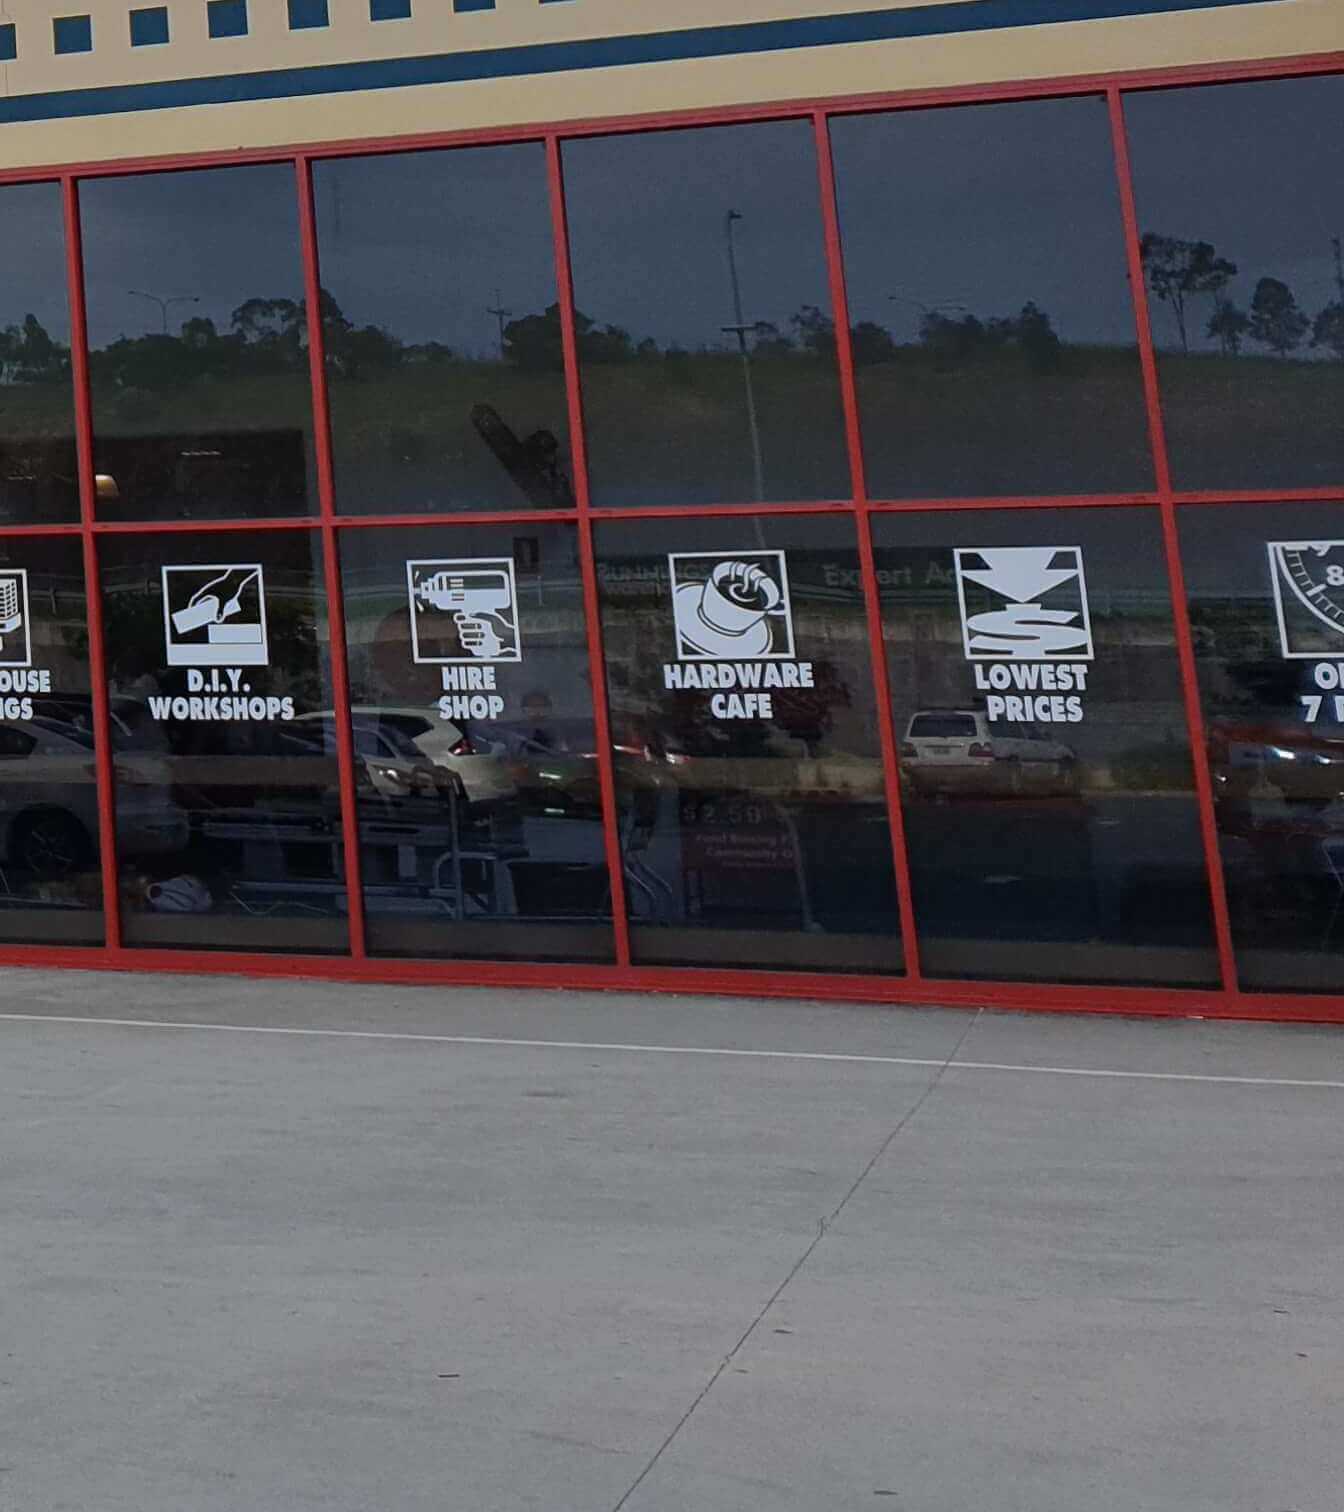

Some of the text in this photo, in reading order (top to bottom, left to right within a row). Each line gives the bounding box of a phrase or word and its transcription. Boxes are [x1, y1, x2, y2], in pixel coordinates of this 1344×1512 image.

[823, 564, 912, 586] Exert
[187, 669, 251, 692] D.I.Y.
[441, 666, 497, 691] HIRE
[663, 662, 814, 689] HARDWARE
[973, 664, 1089, 691] LOWEST
[148, 696, 295, 720] WORKSHOPS
[439, 695, 504, 720] SHOP
[711, 693, 773, 719] CAFE
[986, 695, 1084, 723] PRICES
[1300, 695, 1323, 722] 7
